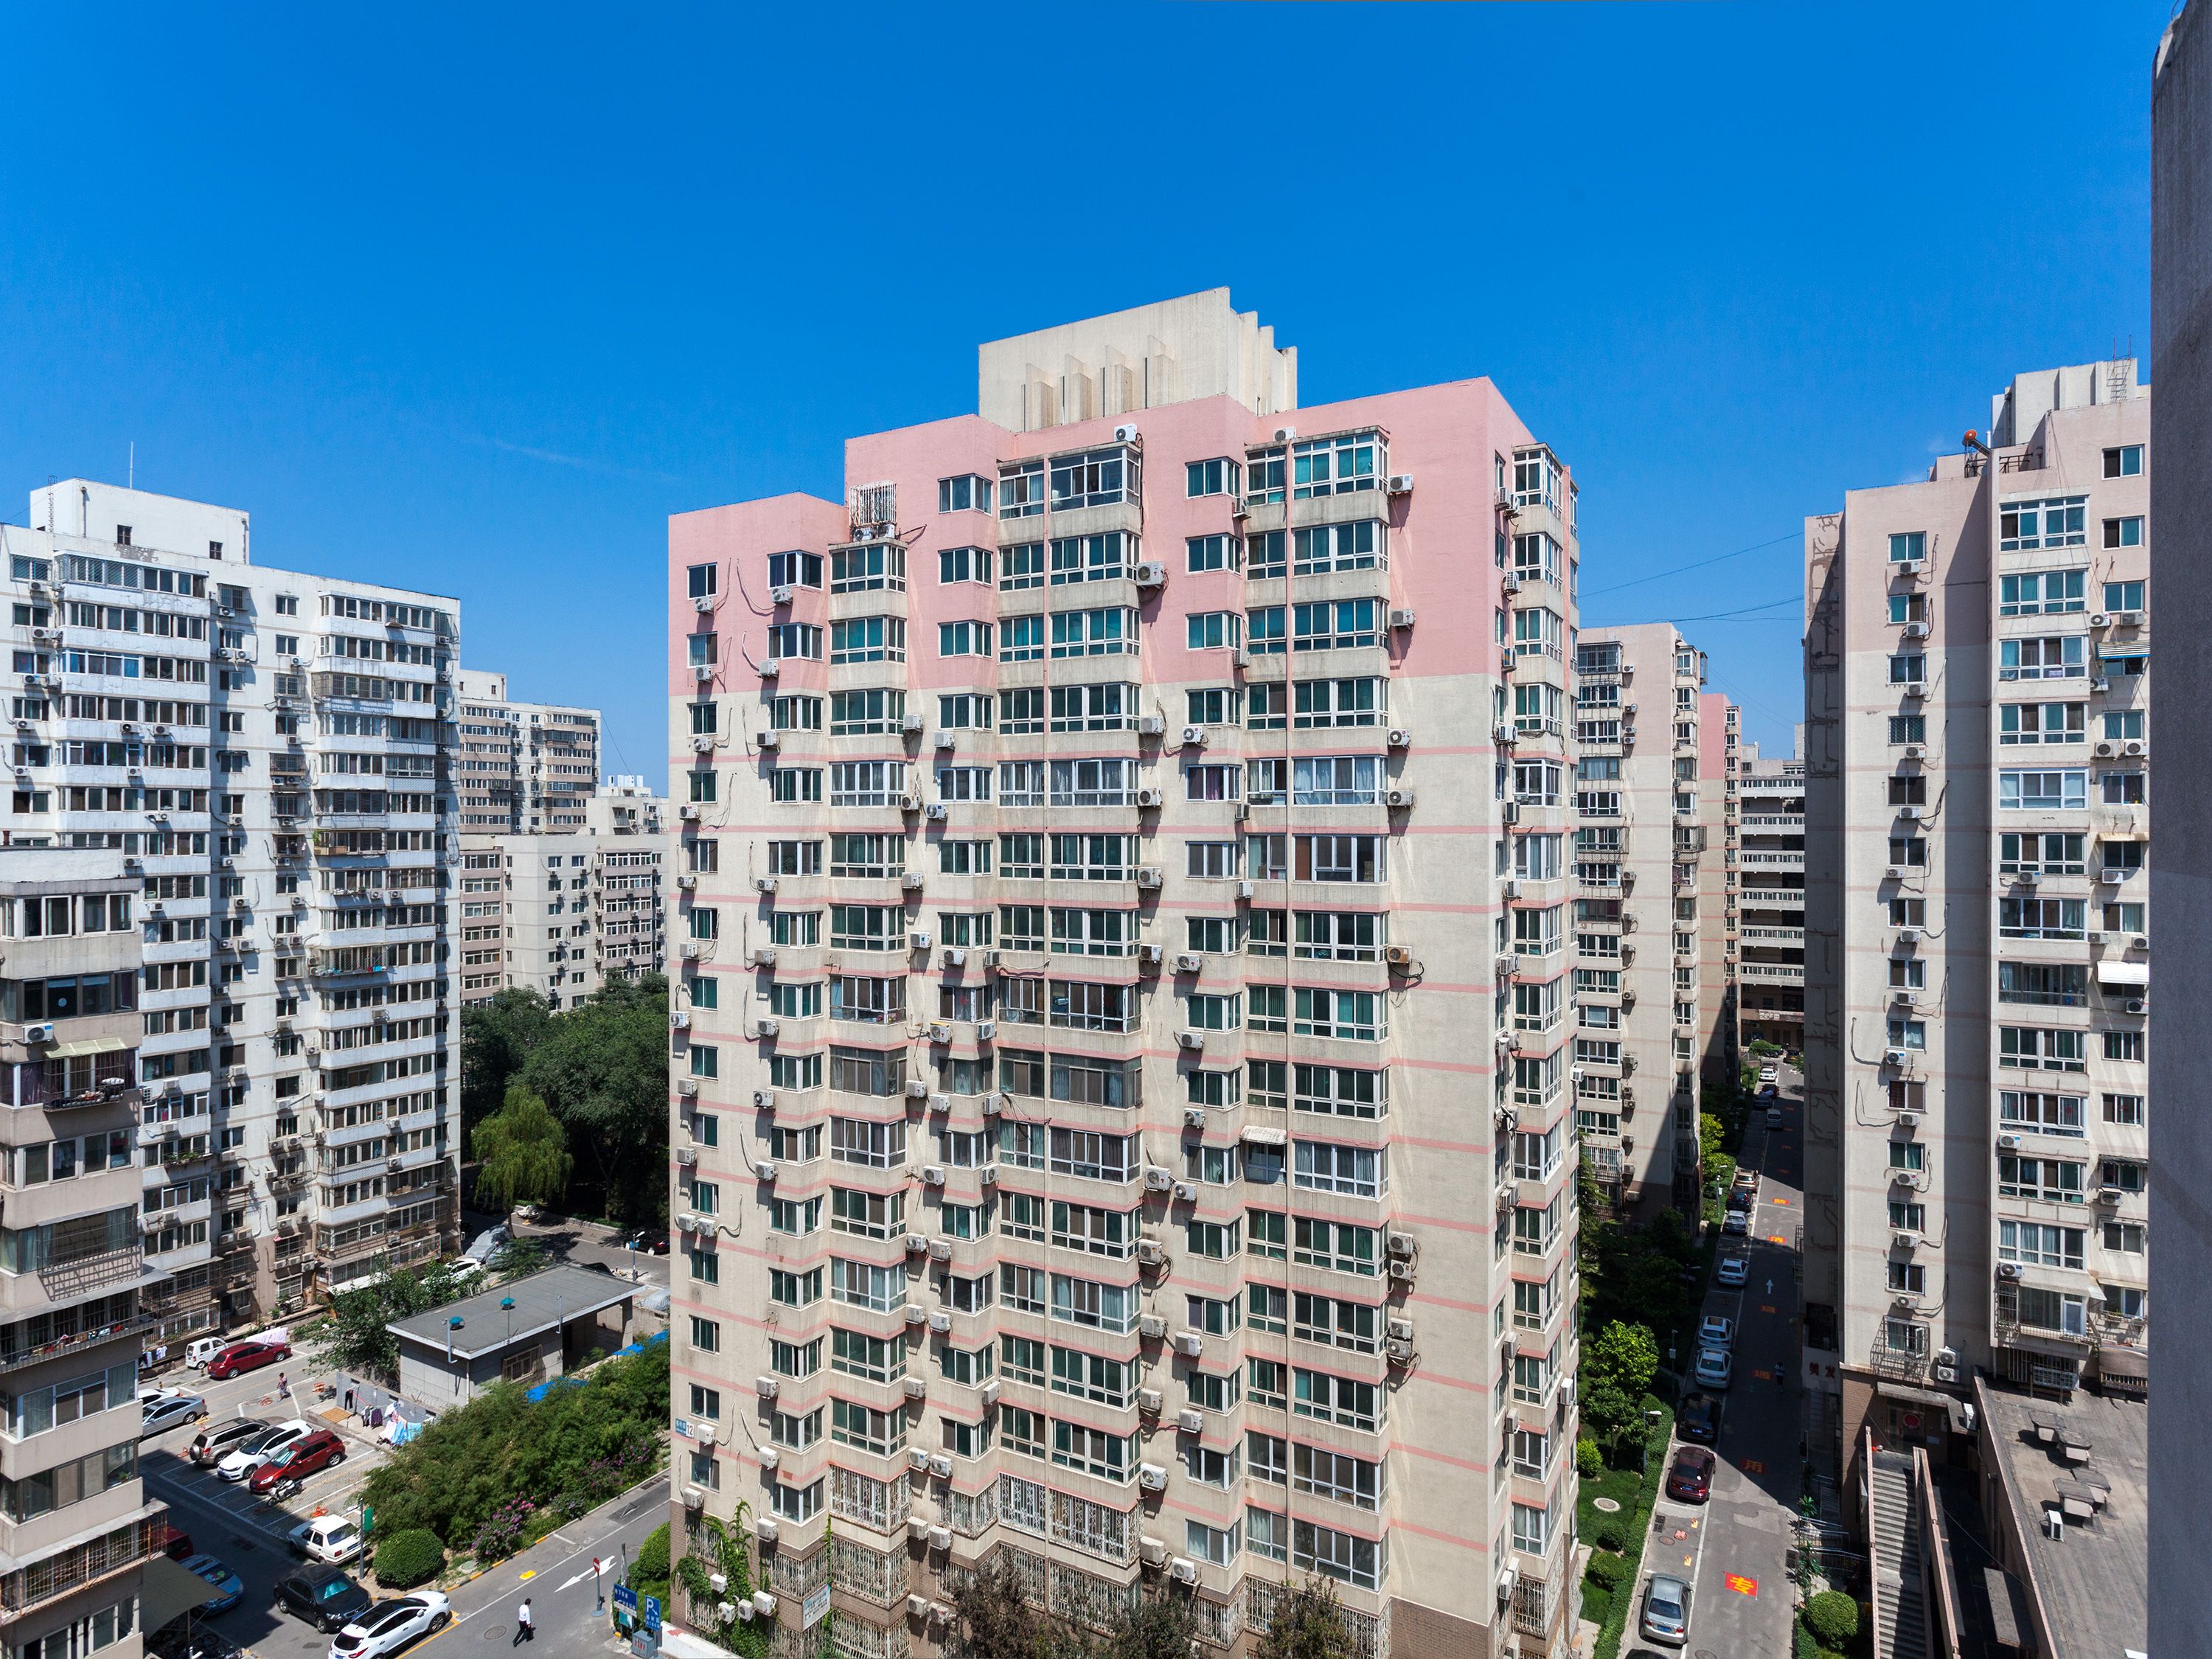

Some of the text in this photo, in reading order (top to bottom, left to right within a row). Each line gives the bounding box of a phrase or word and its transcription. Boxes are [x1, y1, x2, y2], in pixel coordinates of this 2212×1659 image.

[686, 1424, 694, 1436] 12
[1729, 1576, 1754, 1594] 专
[646, 1597, 654, 1613] P
